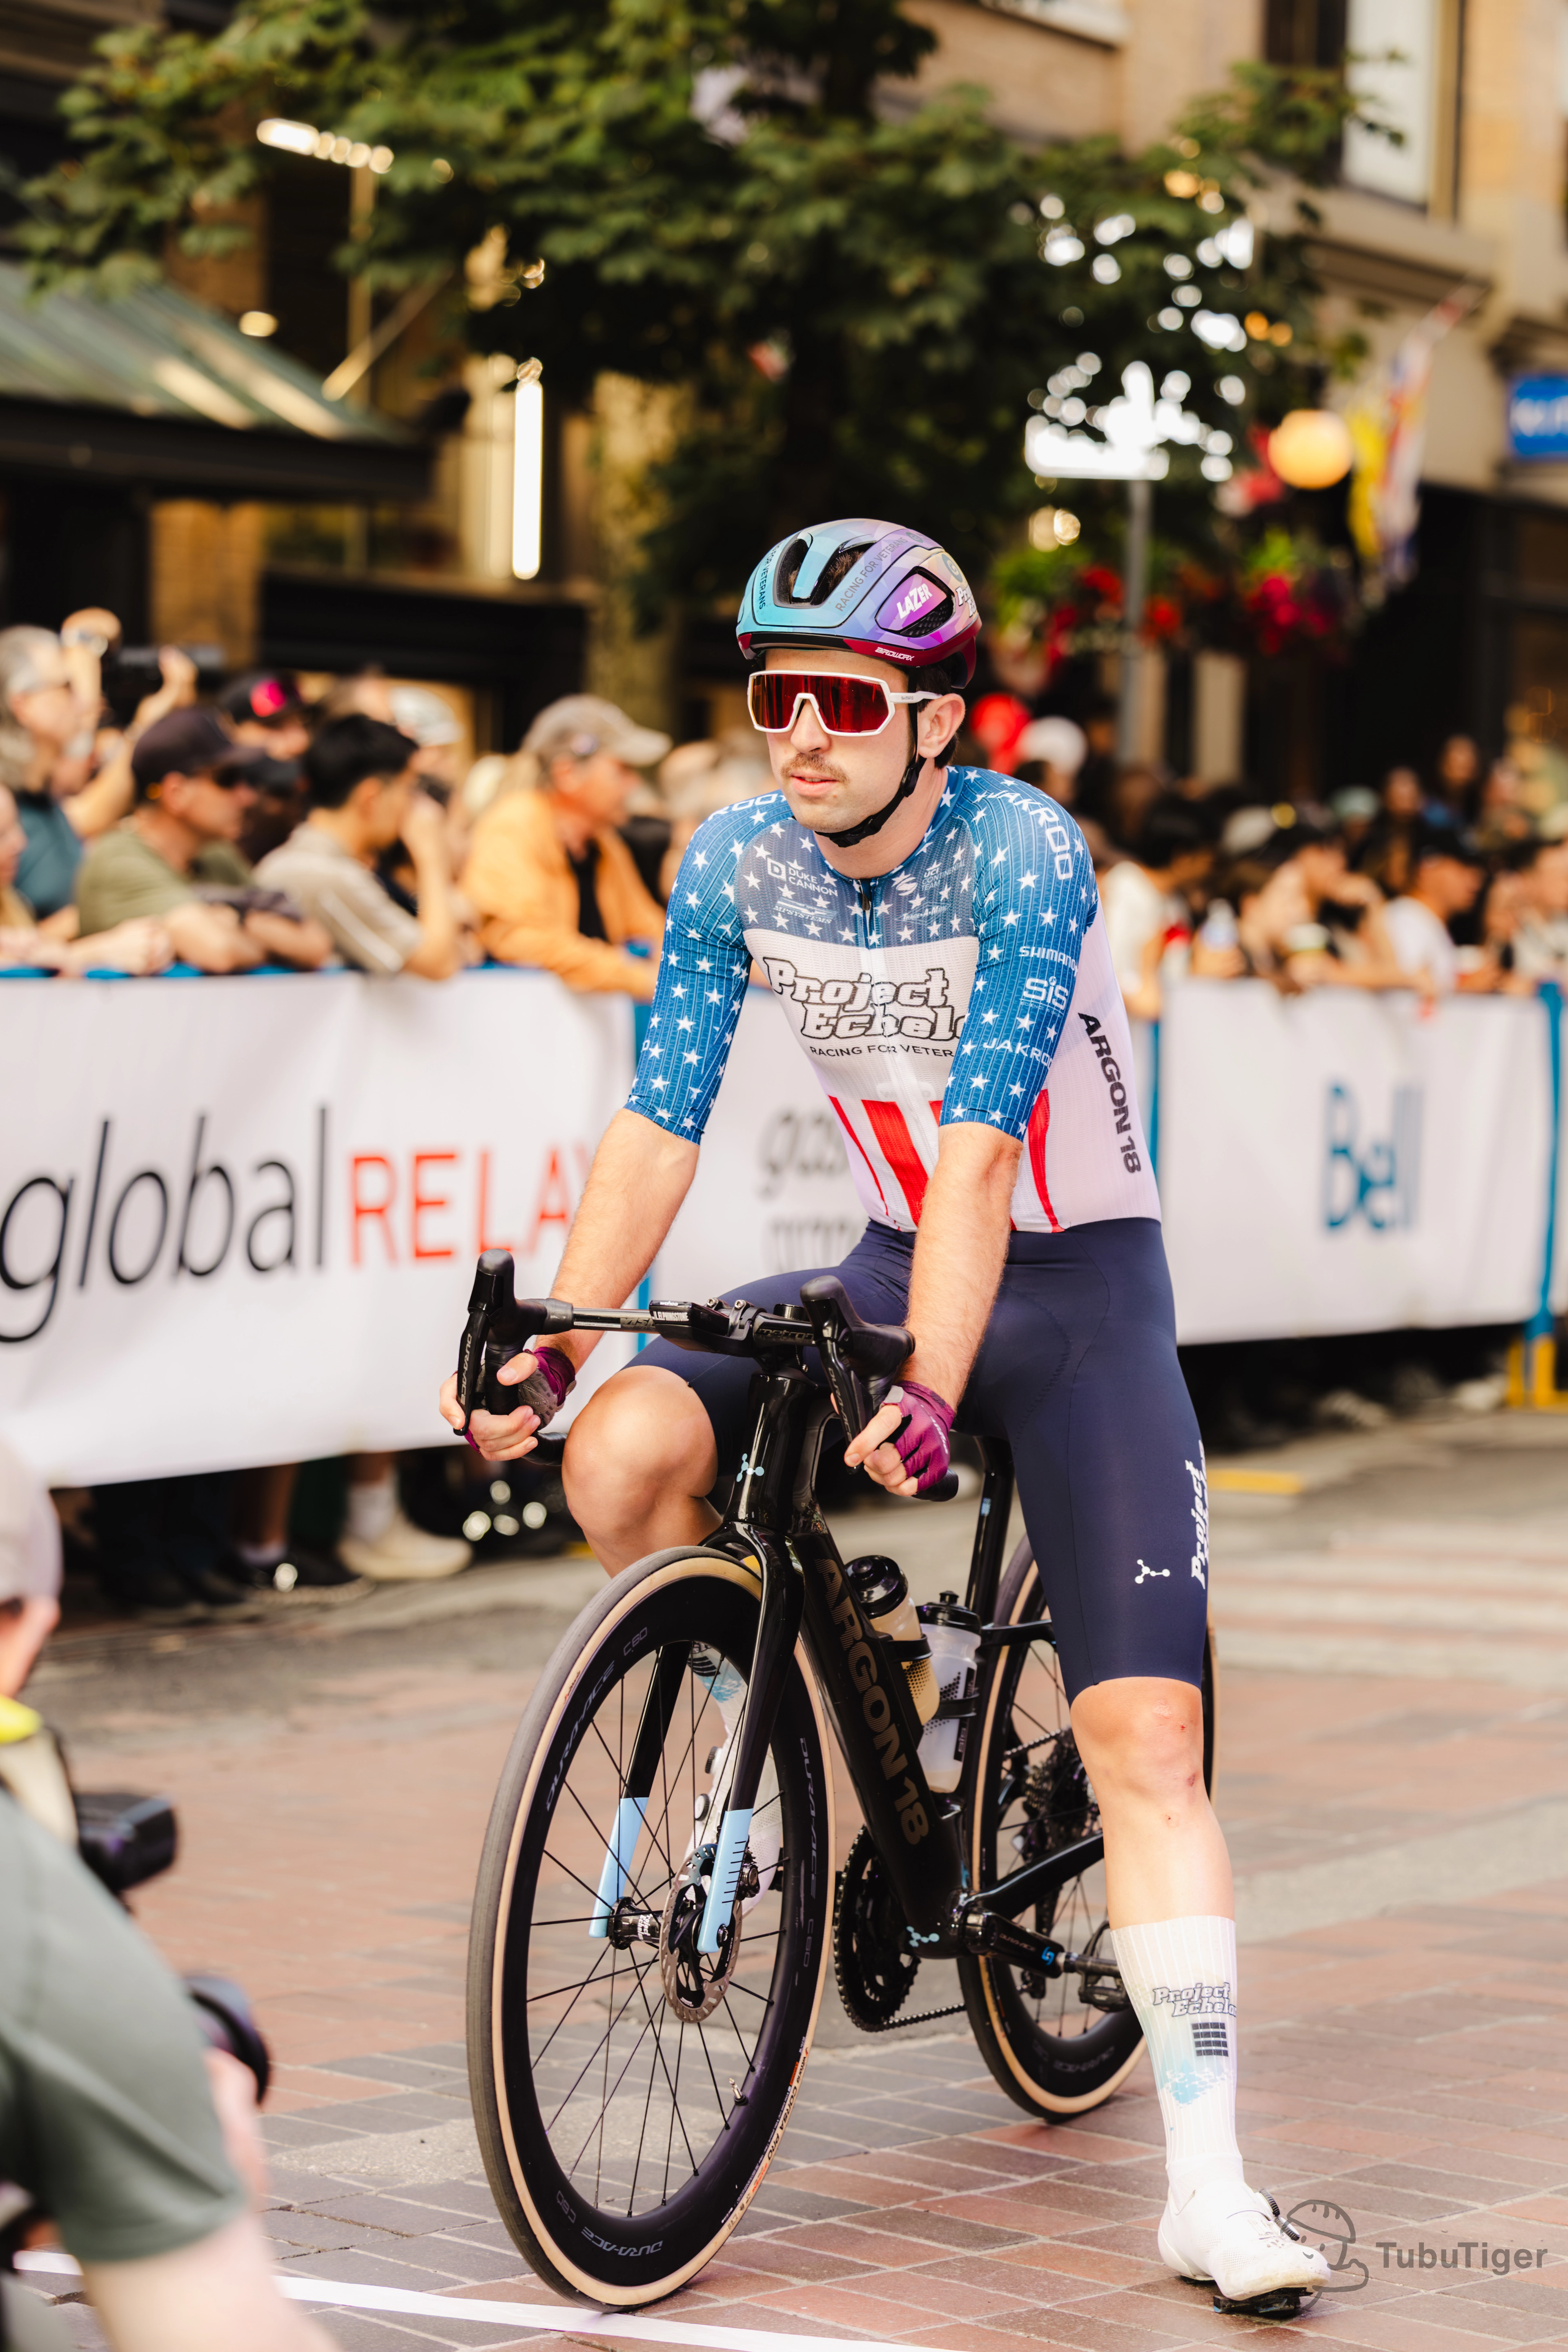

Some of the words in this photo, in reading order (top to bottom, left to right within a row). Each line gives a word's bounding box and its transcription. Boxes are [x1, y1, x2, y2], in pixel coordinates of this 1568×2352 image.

[759, 565, 770, 609] VETERANS
[835, 577, 864, 611] RACING
[860, 561, 879, 578] FOR
[874, 537, 909, 562] VETERANS
[896, 583, 933, 619] LAZER
[987, 789, 1074, 880] JAKROO
[788, 866, 818, 884] DUKE
[788, 876, 838, 897] CANNON
[921, 880, 940, 891] TEAM
[922, 860, 965, 884] CONTINENTAL
[924, 868, 939, 878] UCI
[773, 906, 832, 924] MPSYSTEMS
[1019, 946, 1076, 971] SHIMANO
[763, 956, 949, 1012] Project
[800, 1003, 966, 1040] Echel
[1020, 1001, 1045, 1011] SCIENCE
[810, 1046, 862, 1056] RACING
[867, 1045, 897, 1054] FOR
[900, 1044, 954, 1057] VETER
[1078, 1012, 1131, 1135] ARGON
[1120, 1135, 1141, 1174] 18
[0, 1102, 329, 1343] global
[349, 1144, 588, 1268] RELA
[621, 1317, 654, 1327] VISI
[461, 1333, 472, 1405] DURA-ACE
[1185, 1460, 1205, 1589] Project
[815, 1558, 909, 1780] ARGON
[894, 1776, 929, 1845] 18
[546, 1660, 615, 1812] DURA-ACE
[800, 1737, 817, 1899] DURA-ACE
[1153, 1982, 1230, 2005] Project
[780, 2086, 797, 2130] CORSA
[768, 2133, 780, 2160] PRO
[581, 2227, 664, 2257] DURA-ACE
